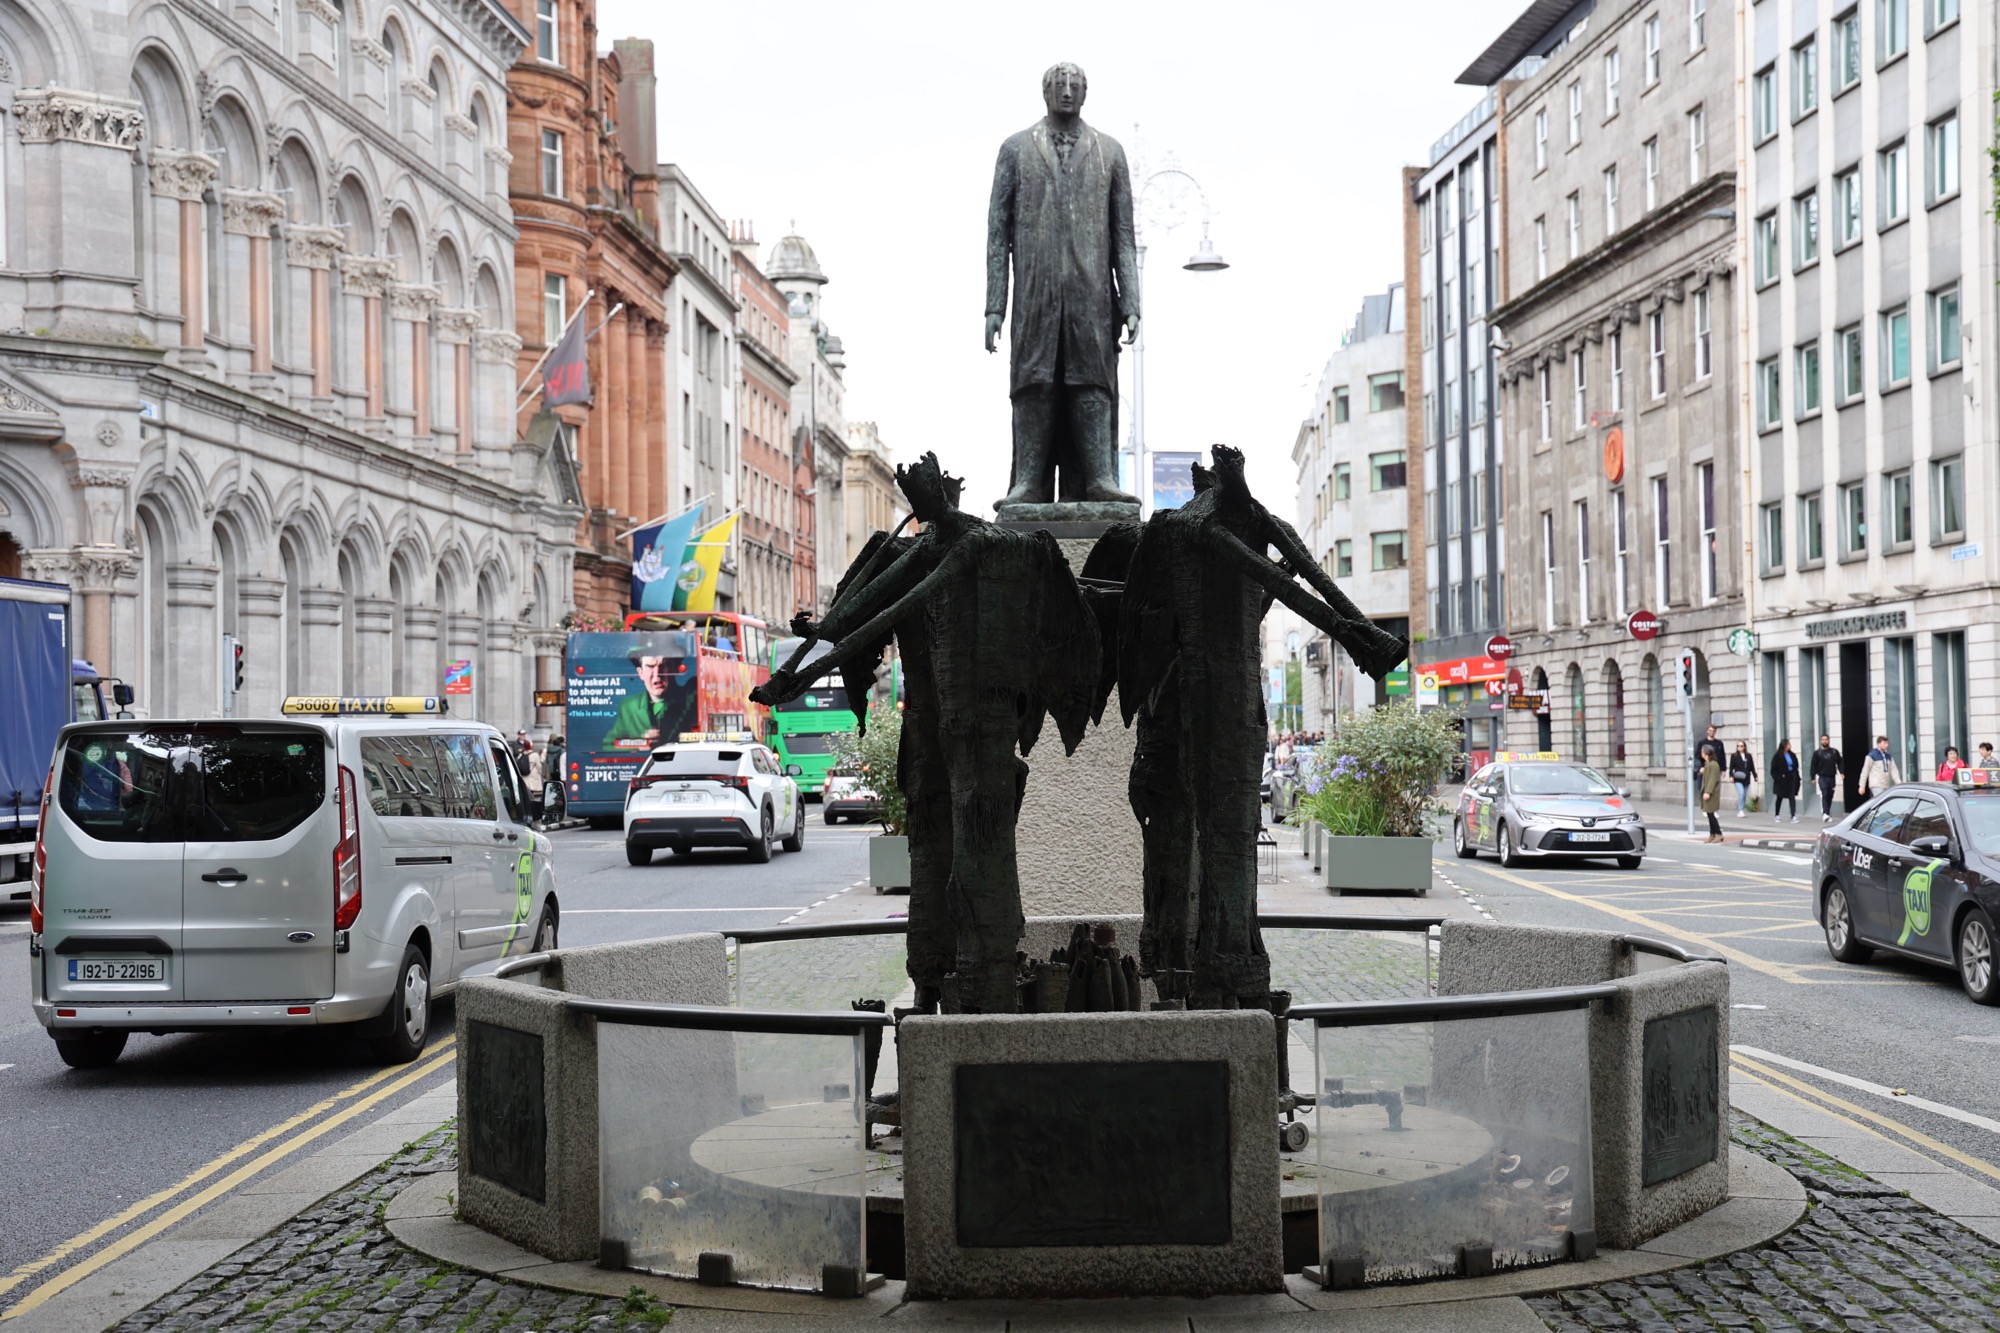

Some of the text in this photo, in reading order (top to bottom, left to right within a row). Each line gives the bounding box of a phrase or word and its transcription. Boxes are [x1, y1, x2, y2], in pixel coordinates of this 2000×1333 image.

[1632, 620, 1657, 628] COSTA
[1805, 611, 1907, 639] STARBUCKS COFFEE
[569, 678, 620, 687] We asked AI
[1489, 682, 1501, 694] K
[569, 688, 578, 696] to
[580, 688, 602, 696] show
[296, 697, 436, 712] 56087 TAXI D
[707, 732, 726, 741] TAXI
[1518, 752, 1536, 761] TAXI
[586, 771, 617, 782] EPIC
[1961, 771, 1971, 782] D
[1852, 845, 1873, 870] Uber
[518, 872, 532, 896] TAXI
[1906, 888, 1928, 914] TAXI
[82, 964, 155, 979] 192-D-22196
